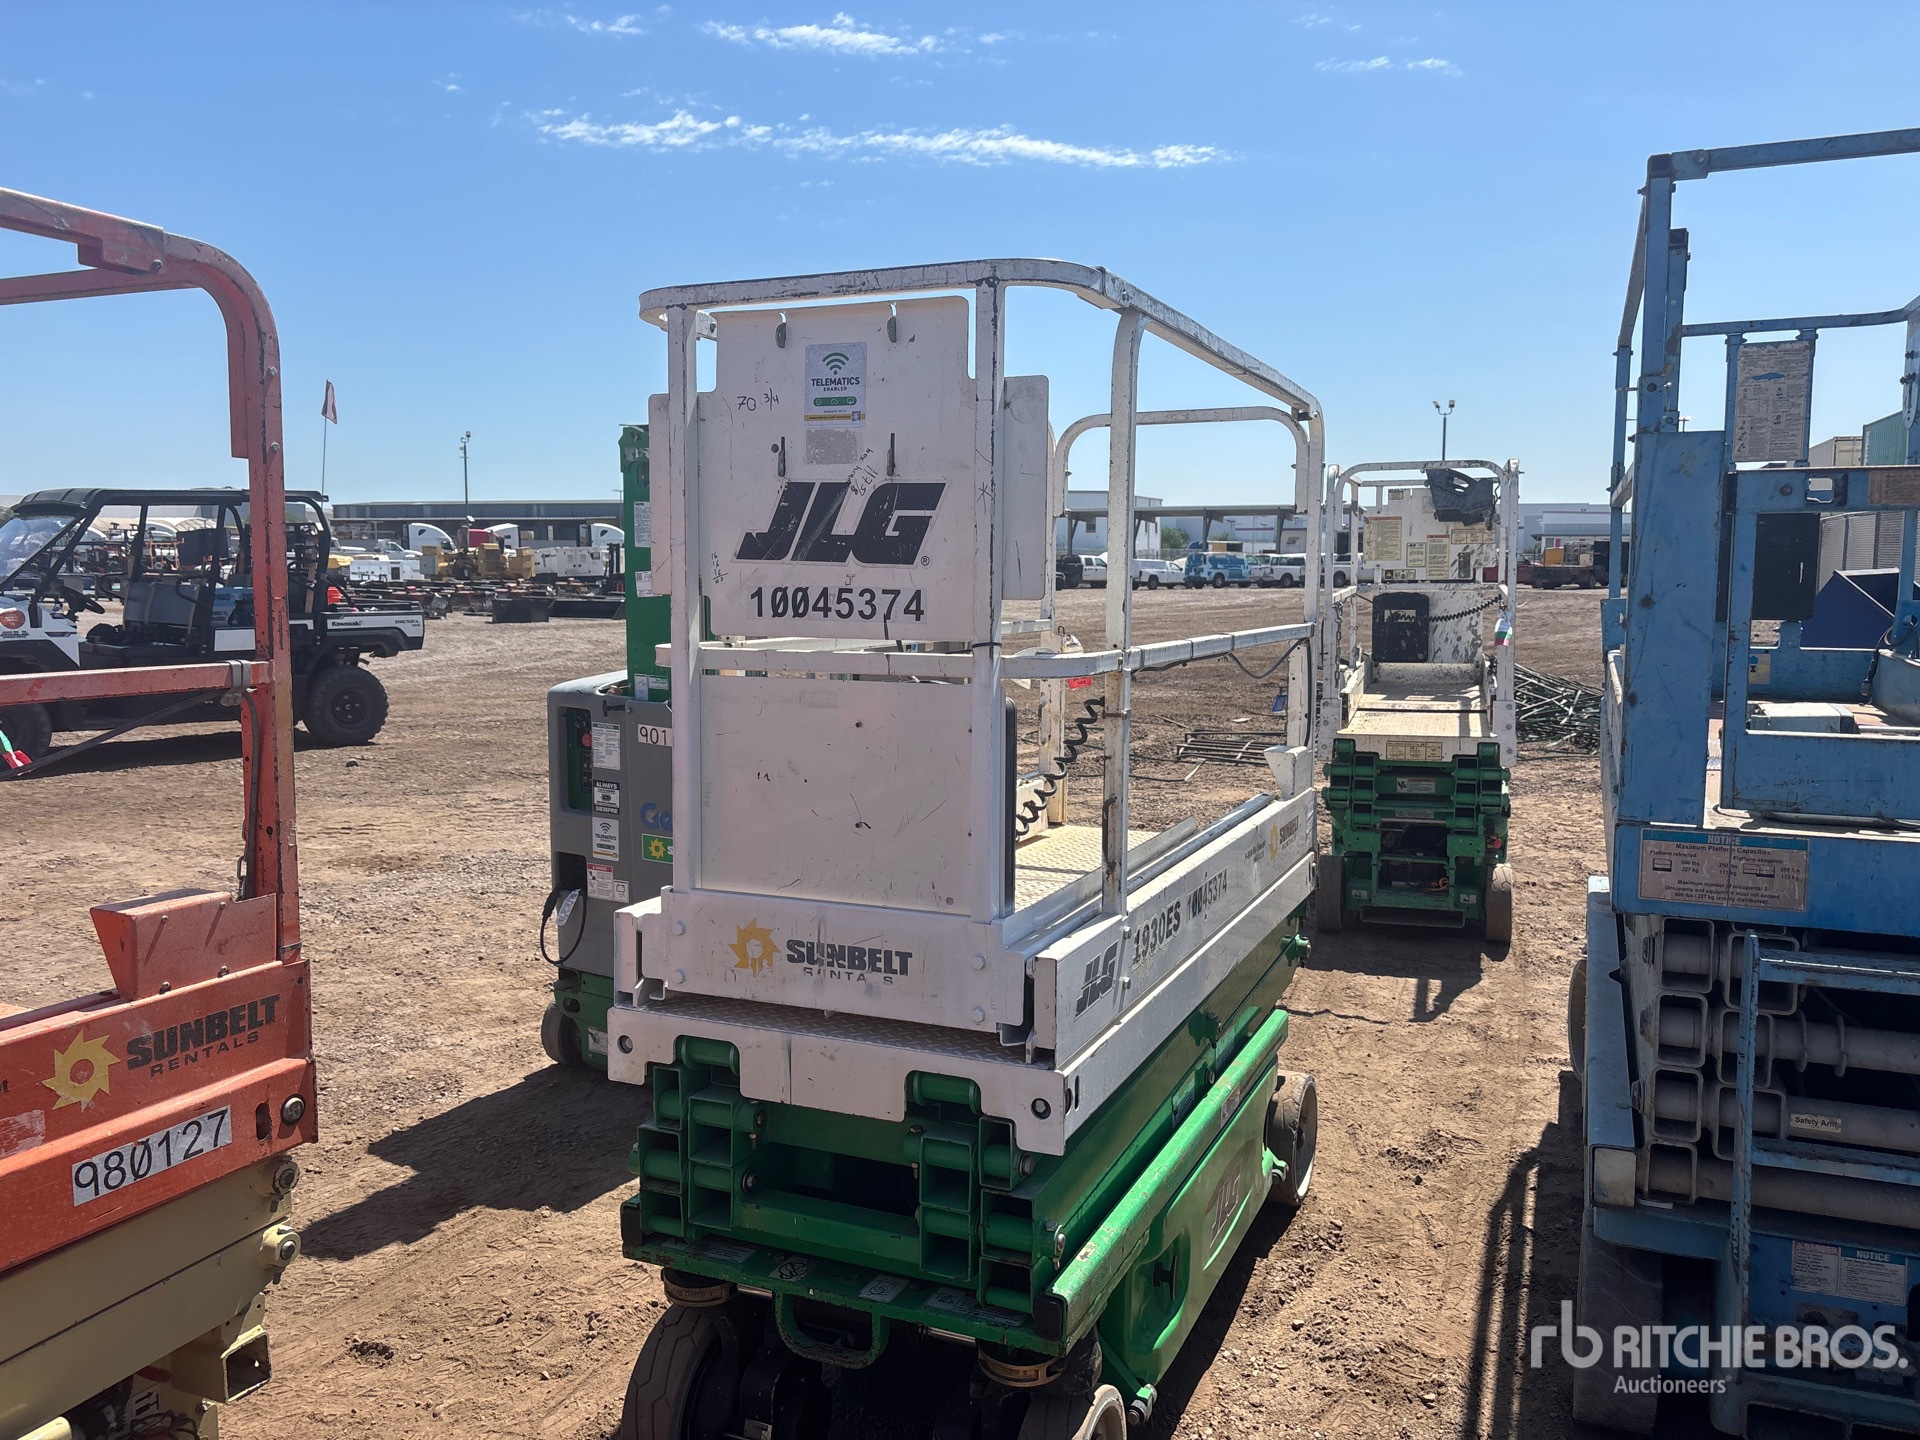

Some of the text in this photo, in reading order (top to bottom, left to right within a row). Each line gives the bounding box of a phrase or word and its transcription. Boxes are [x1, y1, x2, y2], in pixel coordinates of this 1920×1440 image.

[810, 376, 860, 387] TELEMATICS
[737, 387, 779, 411] 70 3/4
[736, 481, 947, 566] JLG
[750, 586, 925, 622] 10045374
[595, 781, 618, 790] ALWAYS
[595, 805, 619, 814] SIEMPRE
[594, 832, 617, 842] TELEMATICS
[1706, 834, 1741, 846] NOTICE
[1650, 849, 1673, 858] Platform
[1675, 843, 1707, 852] Maximum
[1736, 847, 1771, 857] Capacities
[1677, 879, 1703, 887] Maximum
[1188, 868, 1227, 920] 10045374
[1132, 900, 1181, 961] 1930ES
[786, 939, 913, 976] SUNBELT
[126, 994, 280, 1070] SUNBELT
[151, 1030, 259, 1077] RENTALS
[1794, 1116, 1837, 1128] Safety Arm
[74, 1109, 228, 1197] 980127
[1856, 1250, 1890, 1262] NOTICE
